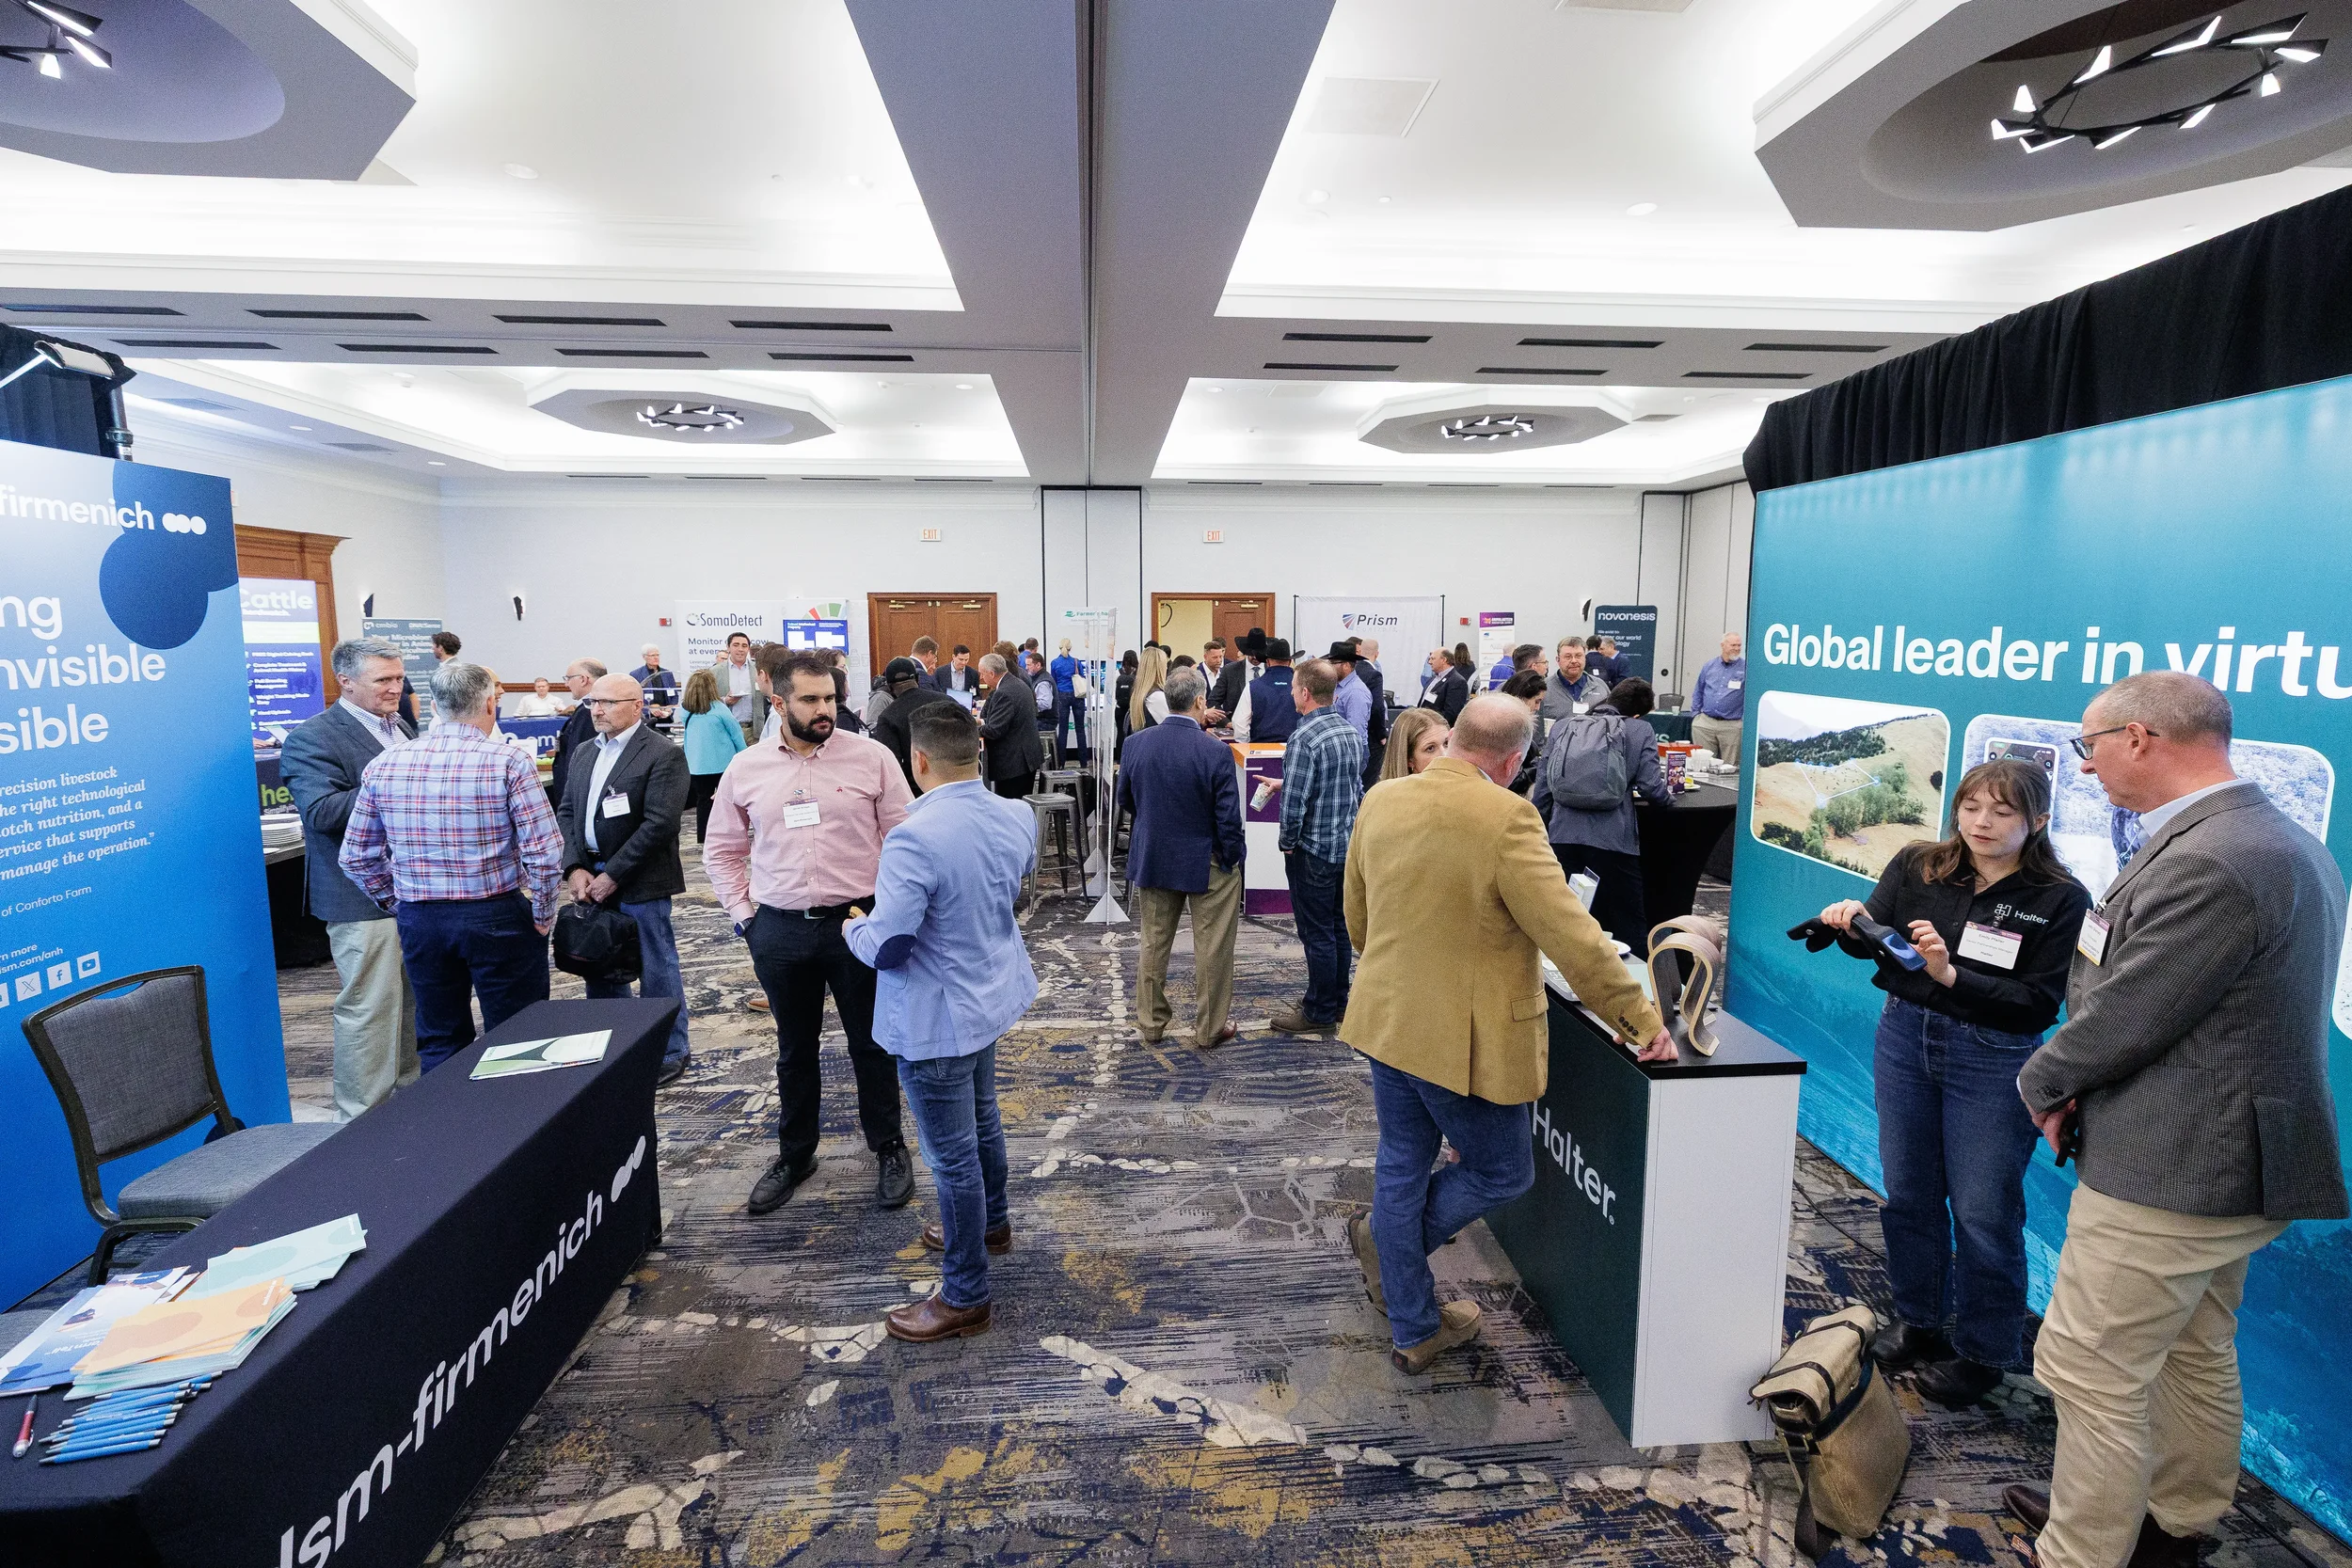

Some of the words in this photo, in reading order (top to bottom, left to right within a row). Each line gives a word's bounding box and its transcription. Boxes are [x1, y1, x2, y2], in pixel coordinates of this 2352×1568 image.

[923, 529, 938, 540] EXIT
[1207, 531, 1221, 541] EXIT
[700, 612, 763, 626] SomaDetect
[1357, 613, 1398, 626] Prism
[1597, 612, 1656, 621] novonesis
[688, 637, 723, 645] Monitor
[1764, 623, 1883, 672] Global
[1893, 625, 2069, 682] leader
[2081, 626, 2144, 685] in
[60, 766, 118, 786] livestock
[21, 797, 58, 815] right
[61, 779, 146, 806] technological
[0, 820, 34, 838] otch
[38, 809, 105, 830] nutrition,
[108, 800, 132, 816] and
[135, 800, 144, 811] a
[46, 831, 76, 847] that
[79, 819, 135, 841] supports
[1, 858, 59, 881] manage
[62, 851, 85, 865] the
[1, 906, 13, 917] of
[15, 894, 63, 913] Conforto
[66, 886, 92, 899] Farm
[2014, 910, 2049, 925] Halter
[10, 943, 38, 958] more
